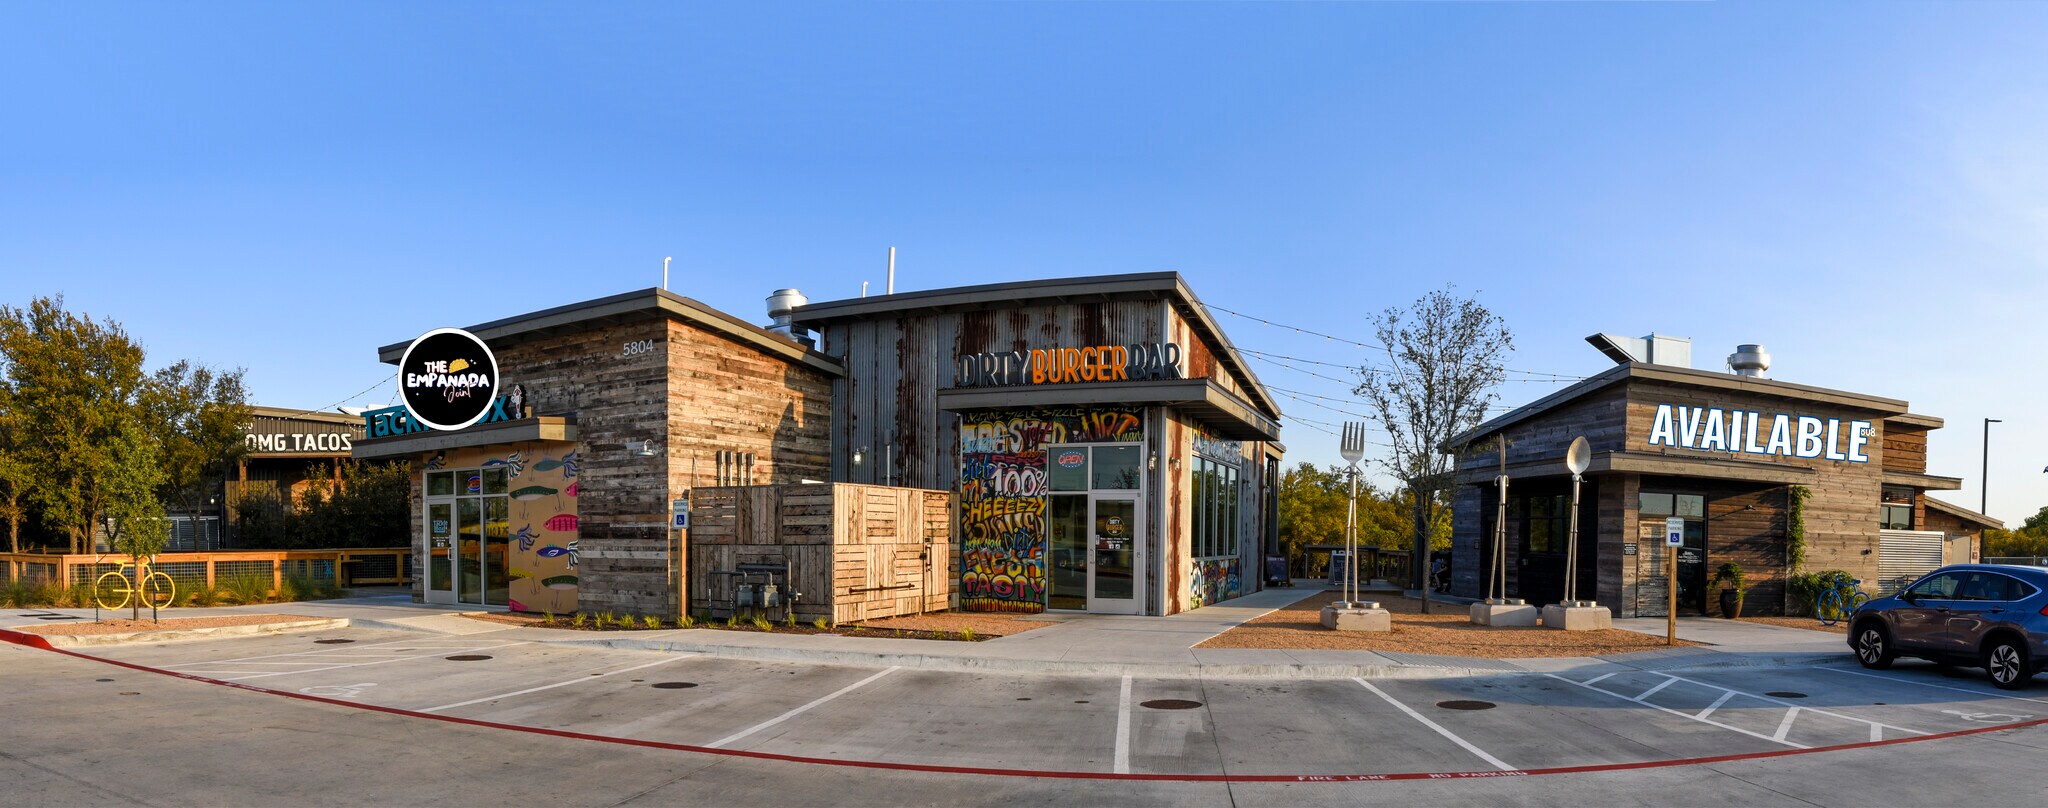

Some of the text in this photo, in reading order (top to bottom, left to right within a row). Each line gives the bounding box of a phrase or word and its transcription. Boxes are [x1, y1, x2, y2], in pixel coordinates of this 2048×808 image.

[623, 339, 654, 356] 5804
[959, 342, 1183, 387] DIRTY BURGER BAR
[245, 434, 353, 452] OMG TACOS
[1058, 455, 1085, 465] OPEN
[991, 465, 1047, 497] 100%
[962, 571, 1046, 602] TASTY
